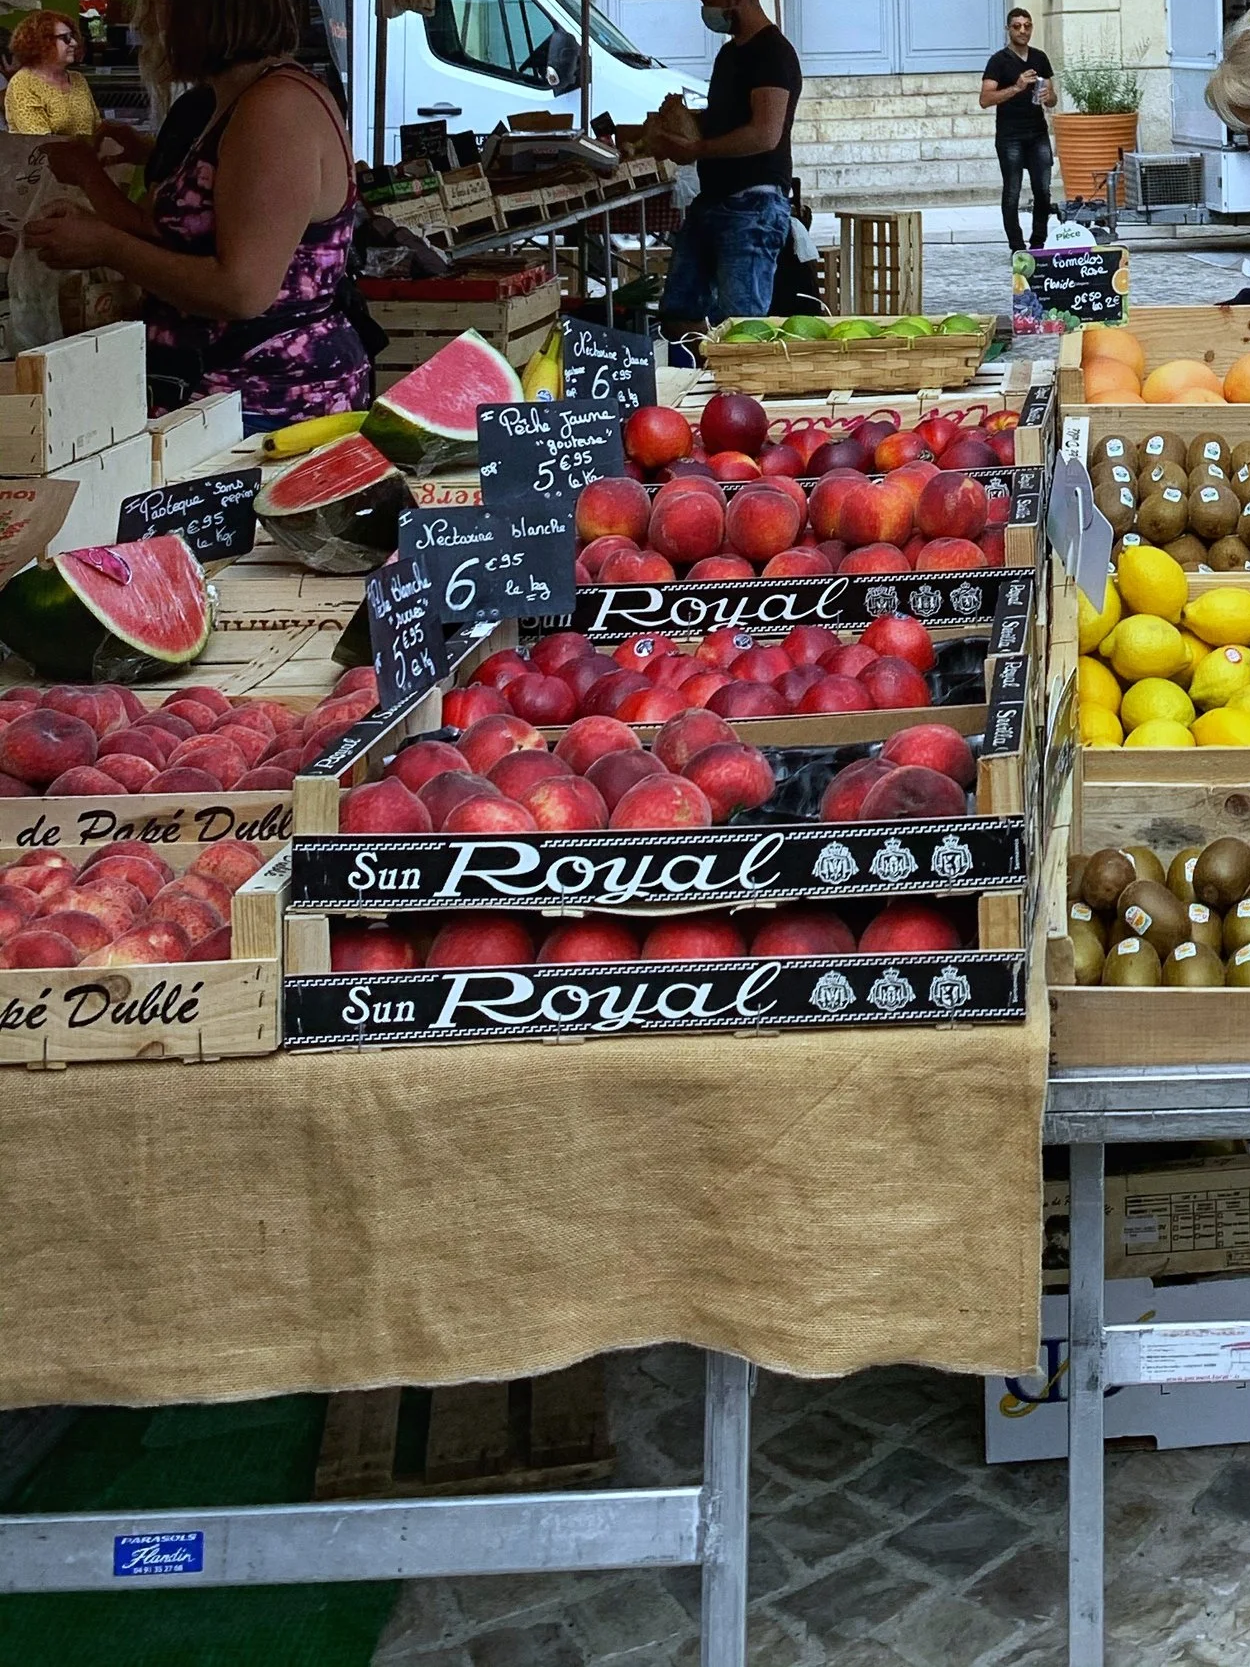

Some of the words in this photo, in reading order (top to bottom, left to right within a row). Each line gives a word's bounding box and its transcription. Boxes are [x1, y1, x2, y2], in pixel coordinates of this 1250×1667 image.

[416, 519, 494, 550] Nectarine
[588, 577, 852, 632] Royal
[17, 815, 61, 846] de
[77, 809, 185, 845] Papé
[195, 803, 293, 842] Dubl
[348, 852, 421, 891] Sun
[433, 832, 786, 905] Royal
[0, 988, 52, 1029] pé
[64, 980, 204, 1028] Dublé
[342, 986, 416, 1025] Sun
[428, 962, 782, 1031] Royal
[121, 1533, 197, 1545] PARASOLS
[122, 1543, 196, 1569] Flandin
